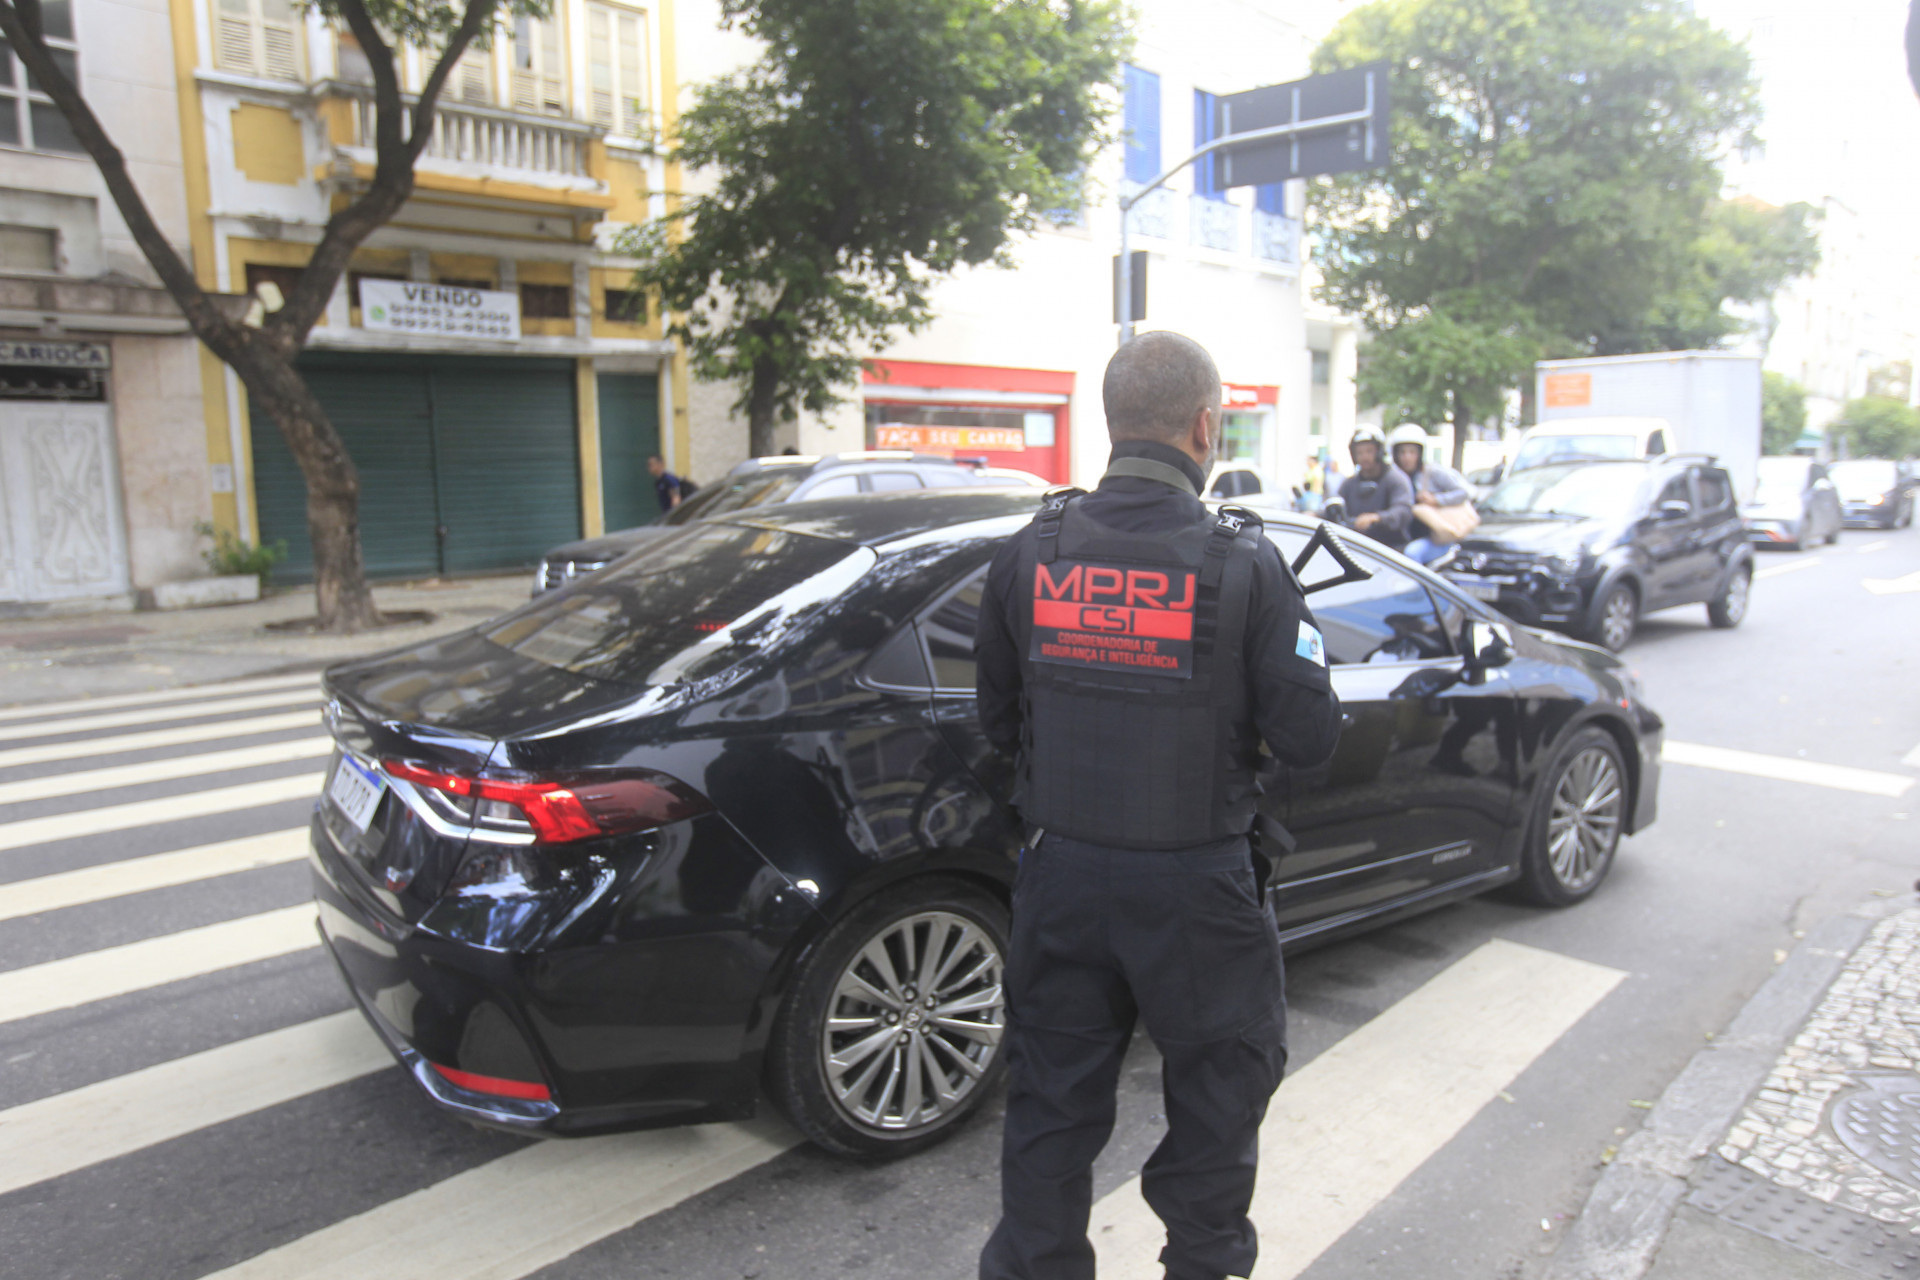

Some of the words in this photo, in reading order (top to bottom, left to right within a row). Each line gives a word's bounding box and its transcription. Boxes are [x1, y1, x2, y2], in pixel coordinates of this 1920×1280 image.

[403, 284, 482, 307] VENDO
[0, 344, 103, 363] CARIOCA
[878, 430, 921, 447] FAÇA
[931, 431, 960, 444] SEU
[1034, 563, 1196, 610] MPRJ
[1079, 606, 1135, 633] CSI
[1057, 631, 1141, 653] COORDENADORIA
[1143, 640, 1158, 653] DE
[1041, 642, 1098, 663] SEGURANÇA
[1100, 651, 1107, 662] E
[1108, 649, 1179, 669] INTELIGÊNCIA
